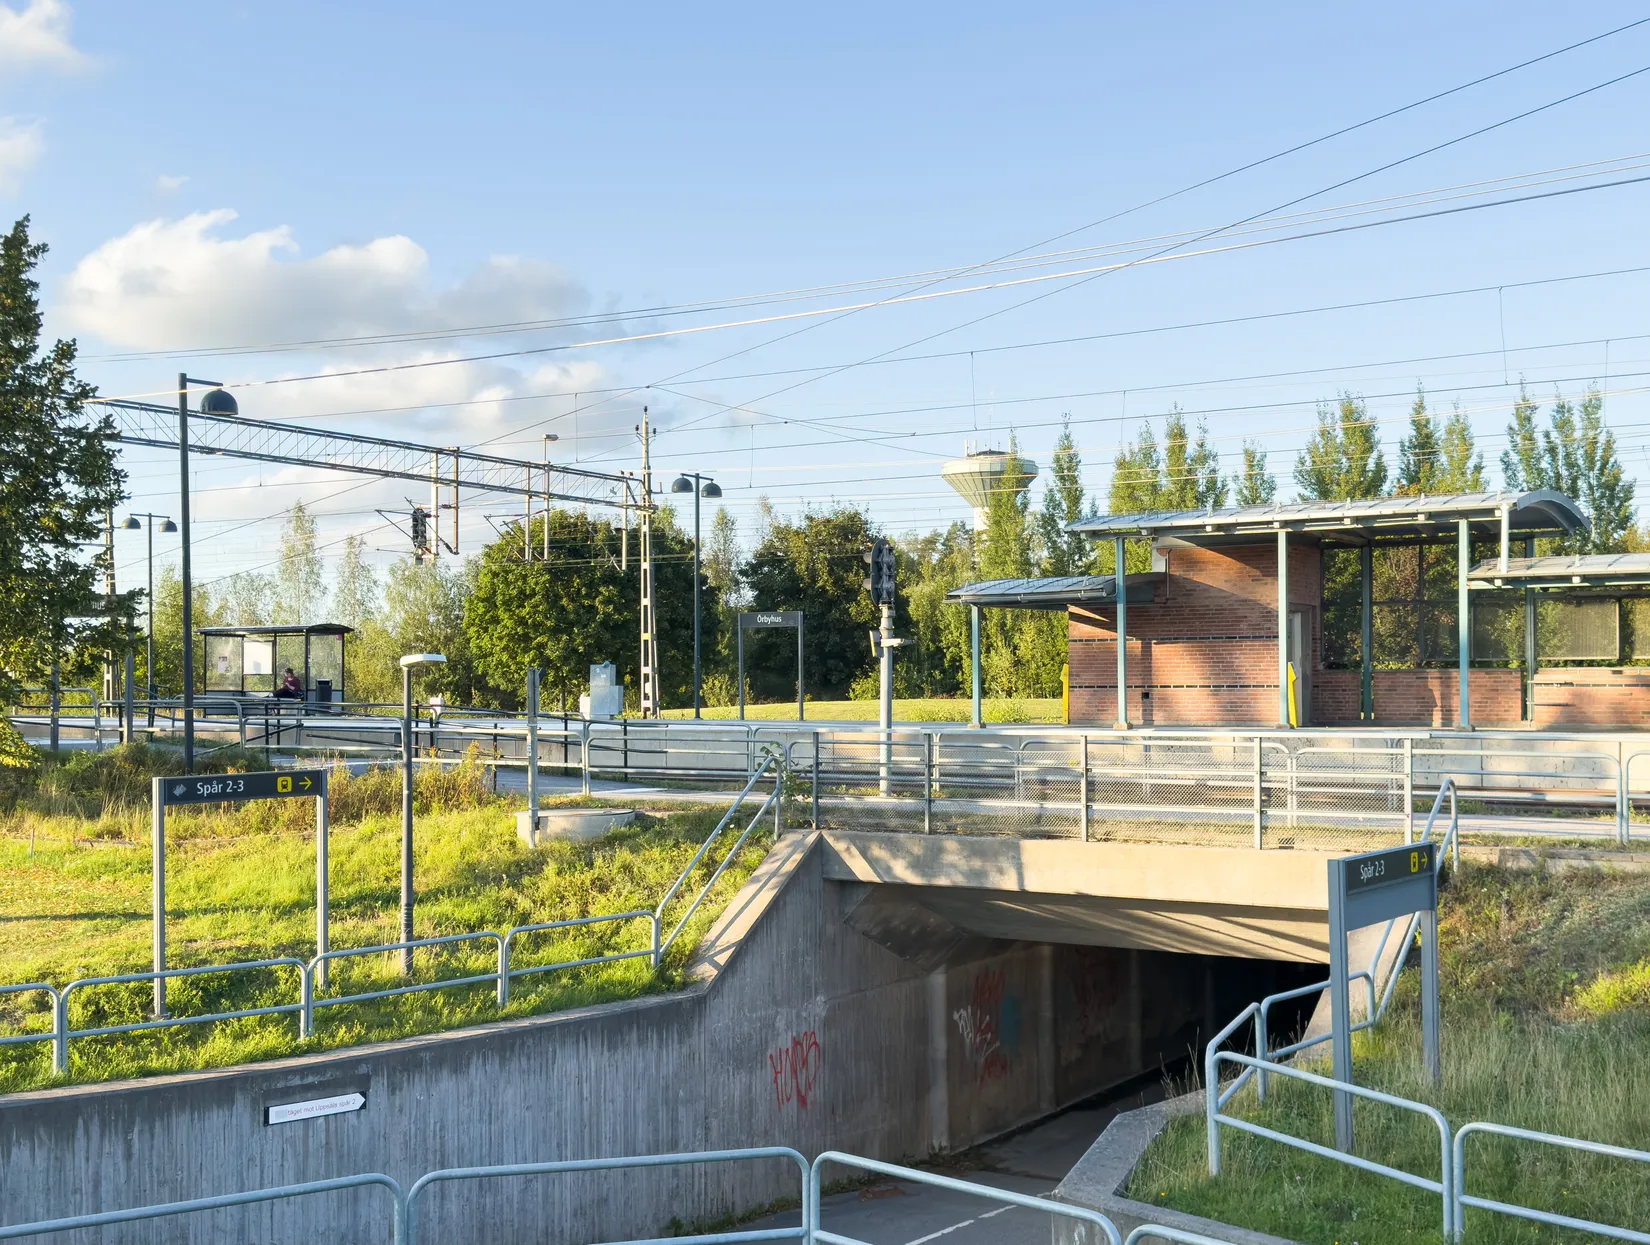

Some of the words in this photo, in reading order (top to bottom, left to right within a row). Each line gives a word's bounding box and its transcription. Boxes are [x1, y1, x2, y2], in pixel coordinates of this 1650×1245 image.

[757, 614, 782, 624] Örbyhus
[197, 780, 223, 797] Spår
[226, 780, 244, 793] 2-3
[1360, 861, 1374, 883] Spår
[1375, 860, 1384, 876] 2-3
[315, 1102, 338, 1112] Uppsala
